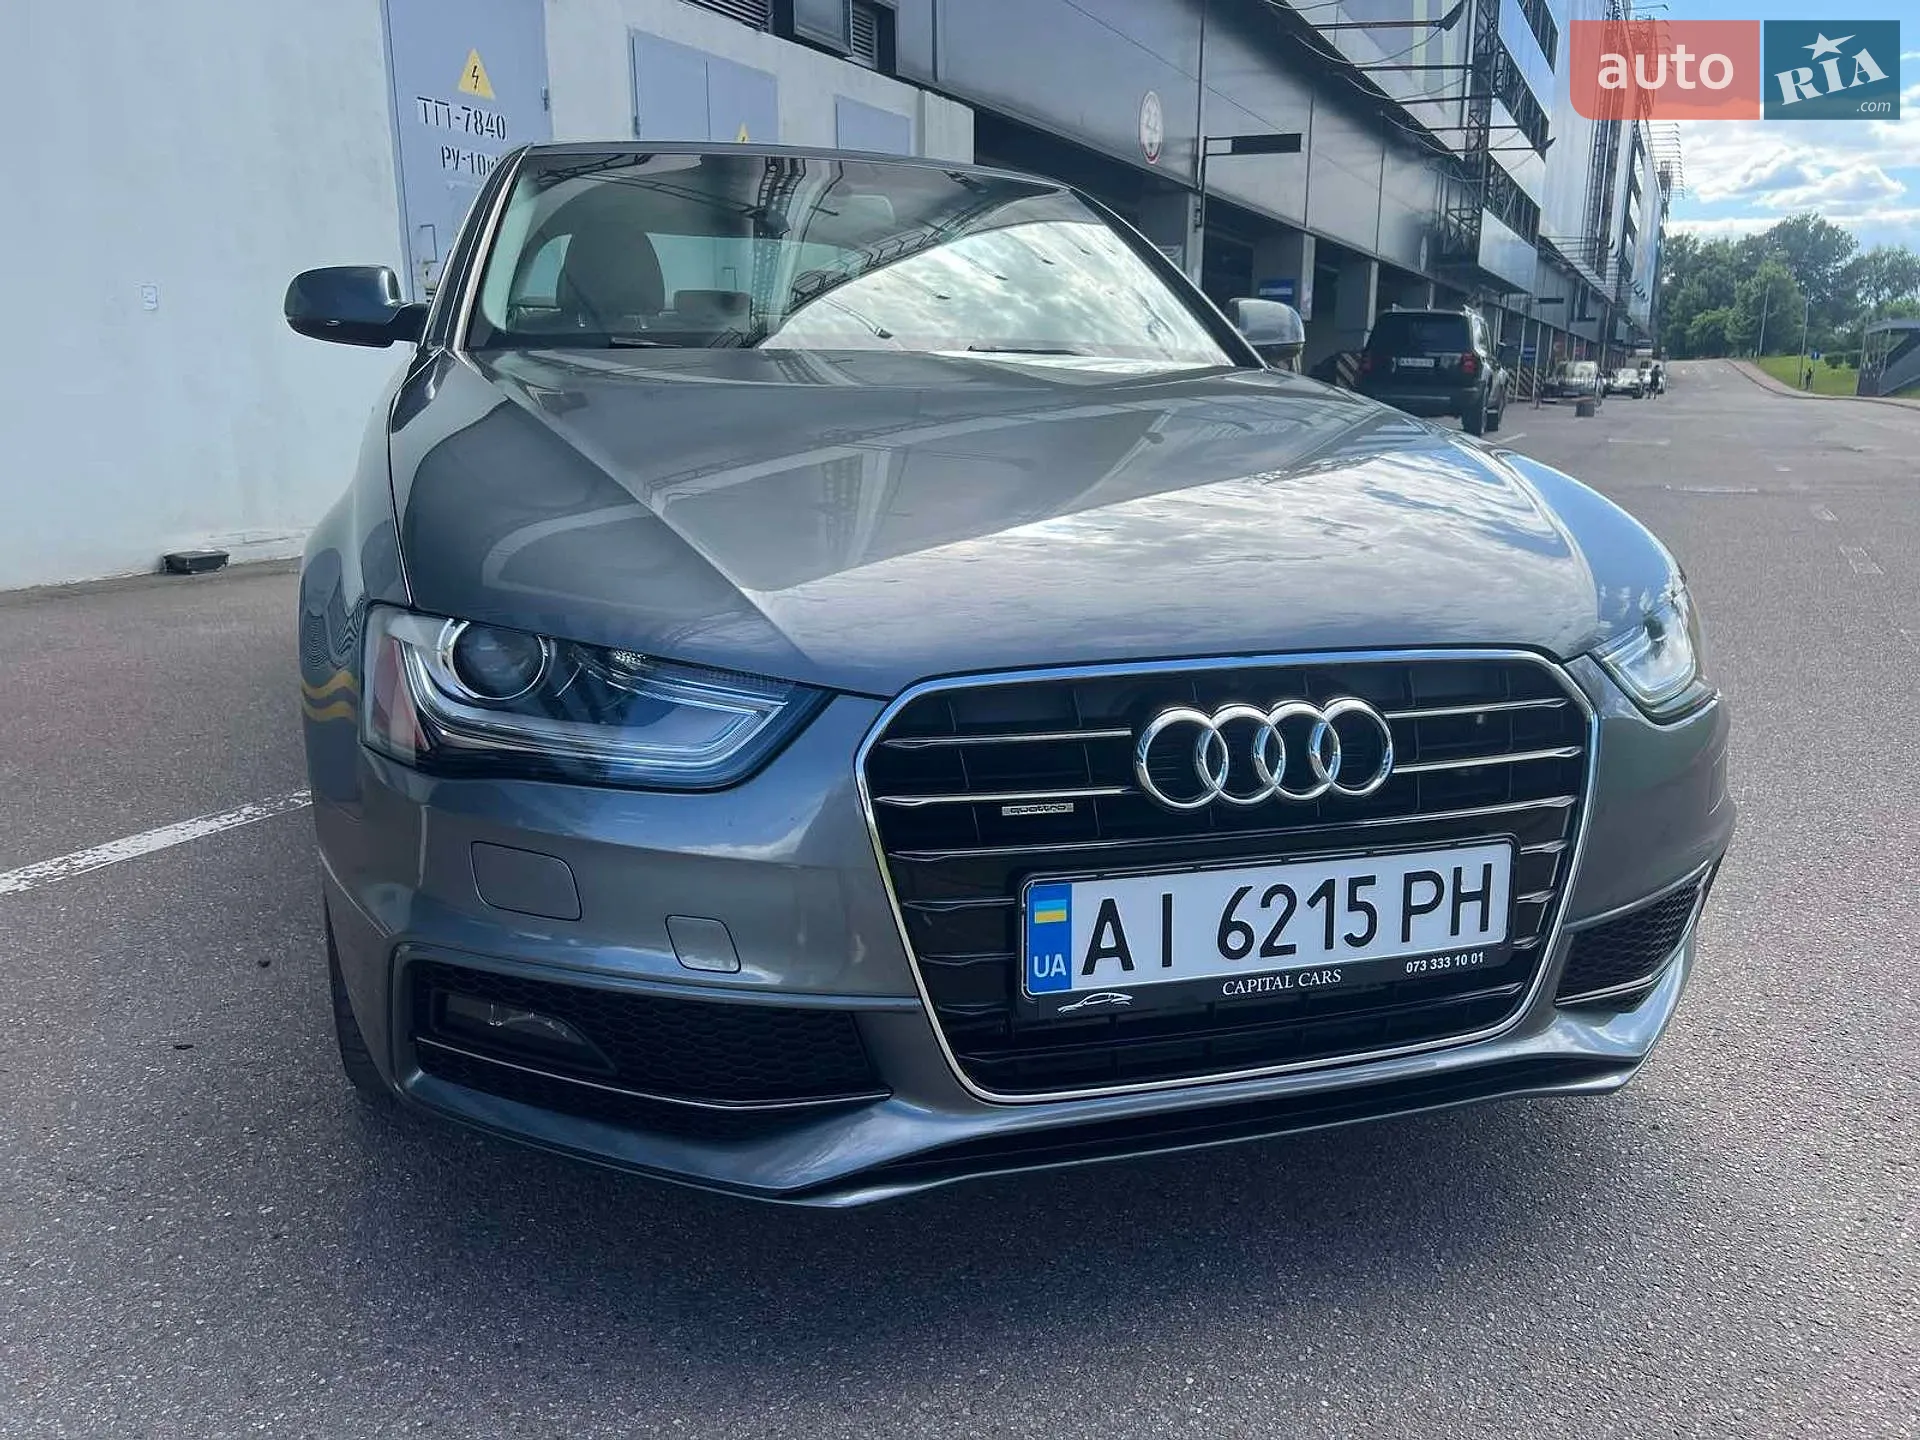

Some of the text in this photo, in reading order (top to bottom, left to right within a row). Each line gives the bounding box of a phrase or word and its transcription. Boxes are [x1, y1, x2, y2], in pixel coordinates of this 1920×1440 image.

[1216, 875, 1379, 961] 6215
[1401, 862, 1494, 944] PH
[1033, 954, 1067, 978] UA
[1406, 951, 1484, 973] 073 333 10 01
[1222, 968, 1342, 996] CAPITAL CARS
